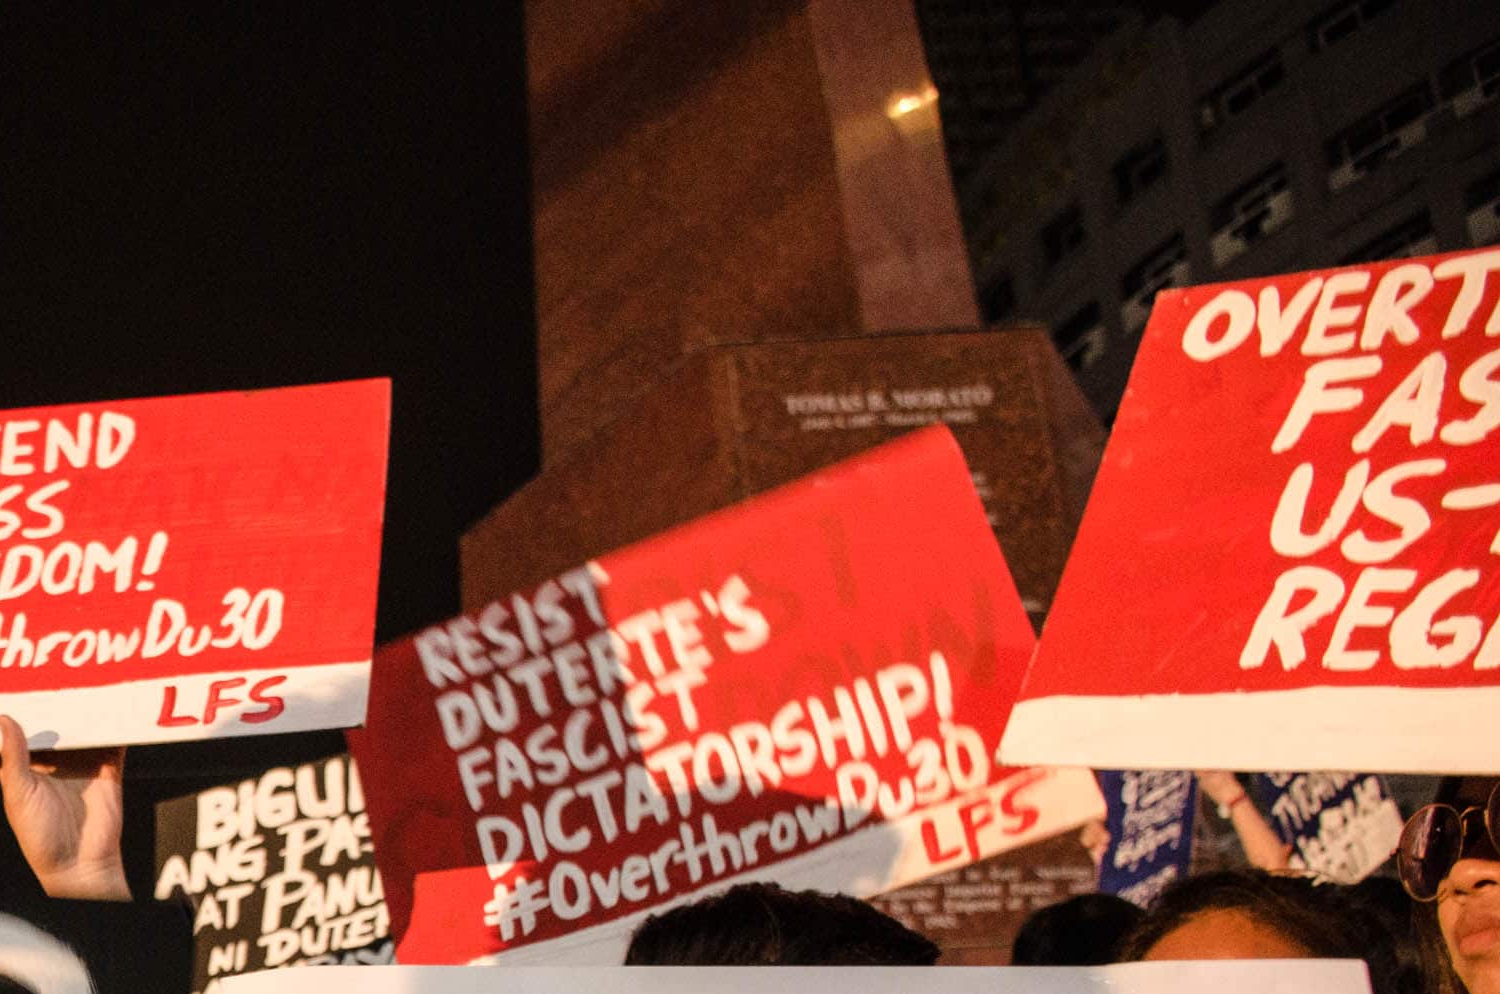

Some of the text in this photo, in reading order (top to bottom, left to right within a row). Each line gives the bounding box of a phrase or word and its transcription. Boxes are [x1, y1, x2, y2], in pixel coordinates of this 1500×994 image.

[1270, 458, 1500, 563] US-
[415, 560, 610, 688] RESIST
[437, 575, 770, 750] DUTERTE'S
[156, 675, 288, 728] LFS
[457, 666, 709, 811] FASCIST
[474, 650, 953, 880] DICTATORSHIP!
[154, 834, 267, 900] ANG
[483, 726, 991, 940] #OverthrowDu30
[919, 788, 1041, 866] LFS
[193, 883, 255, 936] AT
[208, 939, 249, 976] NI
